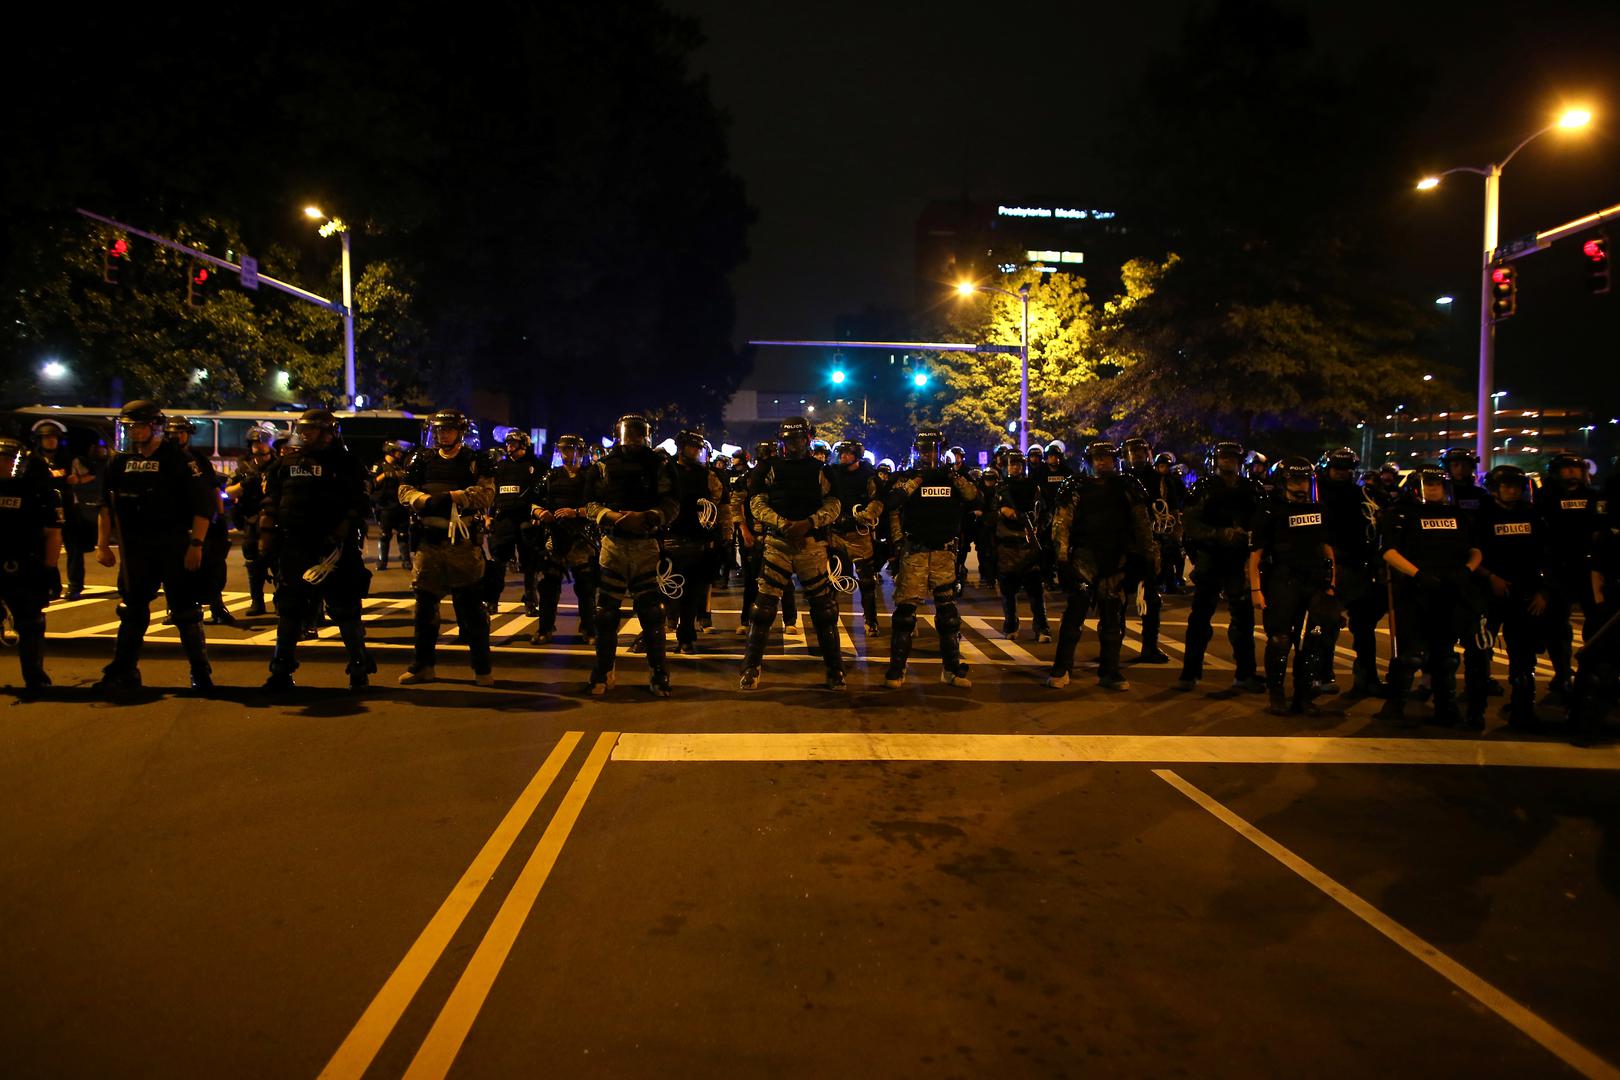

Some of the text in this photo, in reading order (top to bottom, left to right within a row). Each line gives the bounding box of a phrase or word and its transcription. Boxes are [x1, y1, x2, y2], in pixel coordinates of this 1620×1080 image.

[126, 461, 158, 471] POLICE
[922, 488, 950, 496] POLICE
[0, 497, 20, 507] ICE
[1290, 514, 1320, 525] POLICE
[1422, 520, 1455, 528] POLICE
[1496, 524, 1529, 534] POLICE
